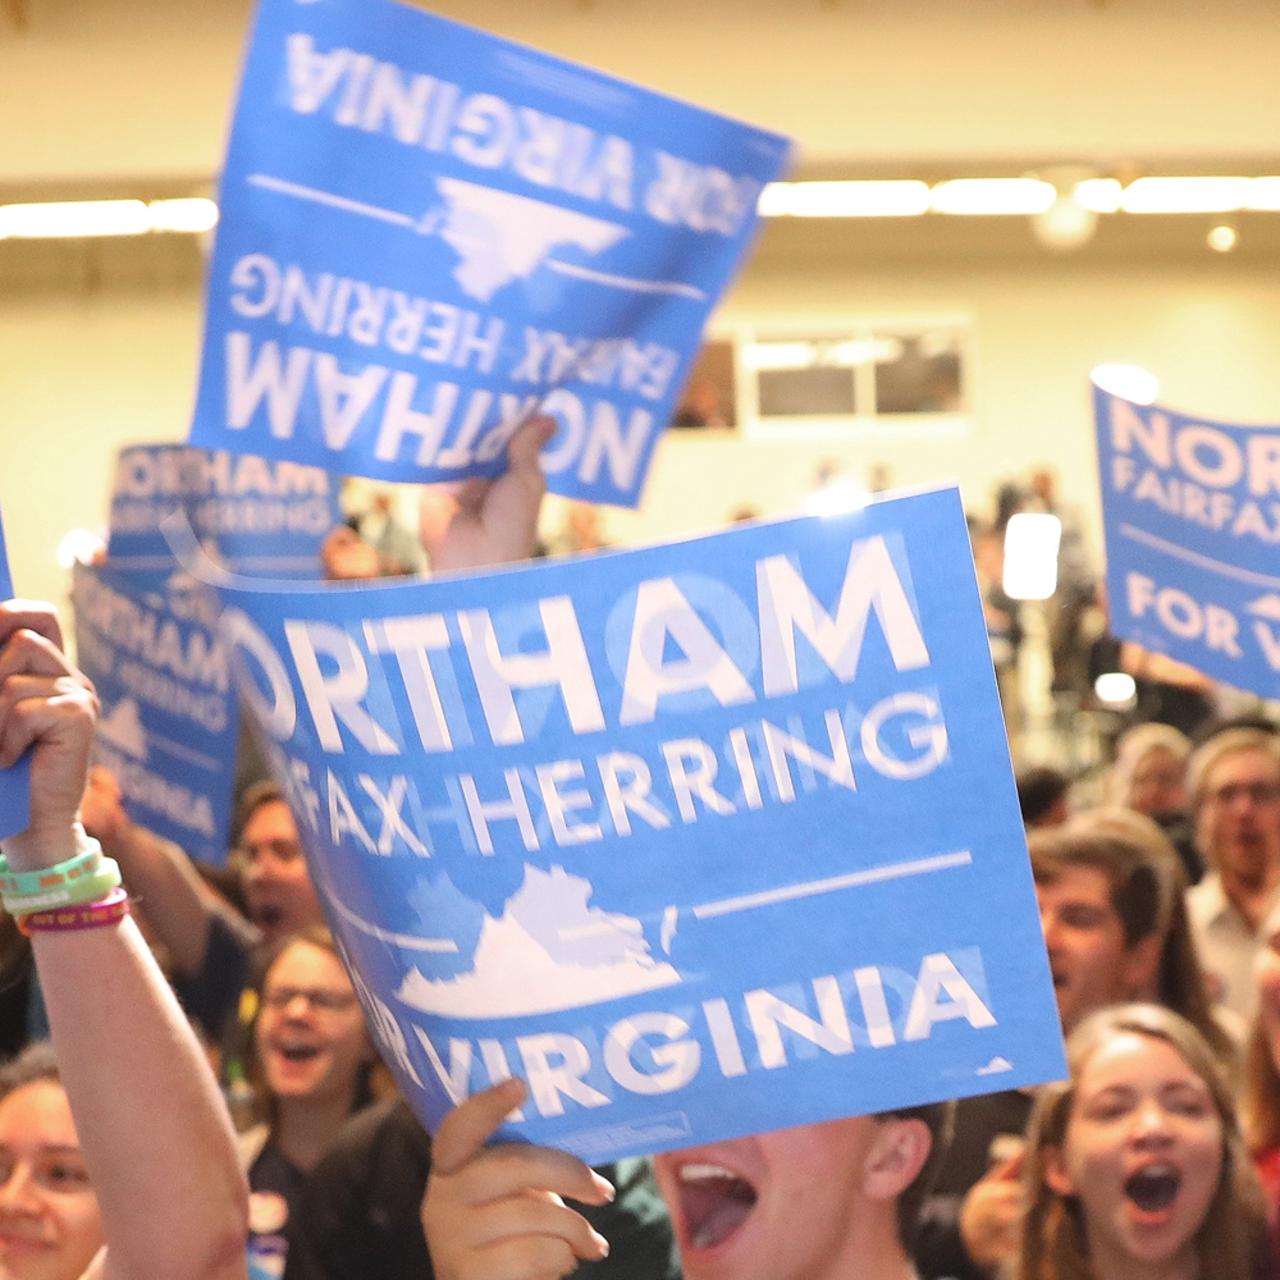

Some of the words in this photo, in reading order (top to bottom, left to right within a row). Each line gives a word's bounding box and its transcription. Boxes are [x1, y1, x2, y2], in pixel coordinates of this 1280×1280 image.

[284, 34, 634, 212] VIRGINIA
[231, 253, 504, 375] HERRING
[218, 534, 932, 756] ORTHAM
[1125, 571, 1243, 657] FOR
[459, 692, 950, 857] HERRING
[412, 952, 998, 1123] VIRGINIA
